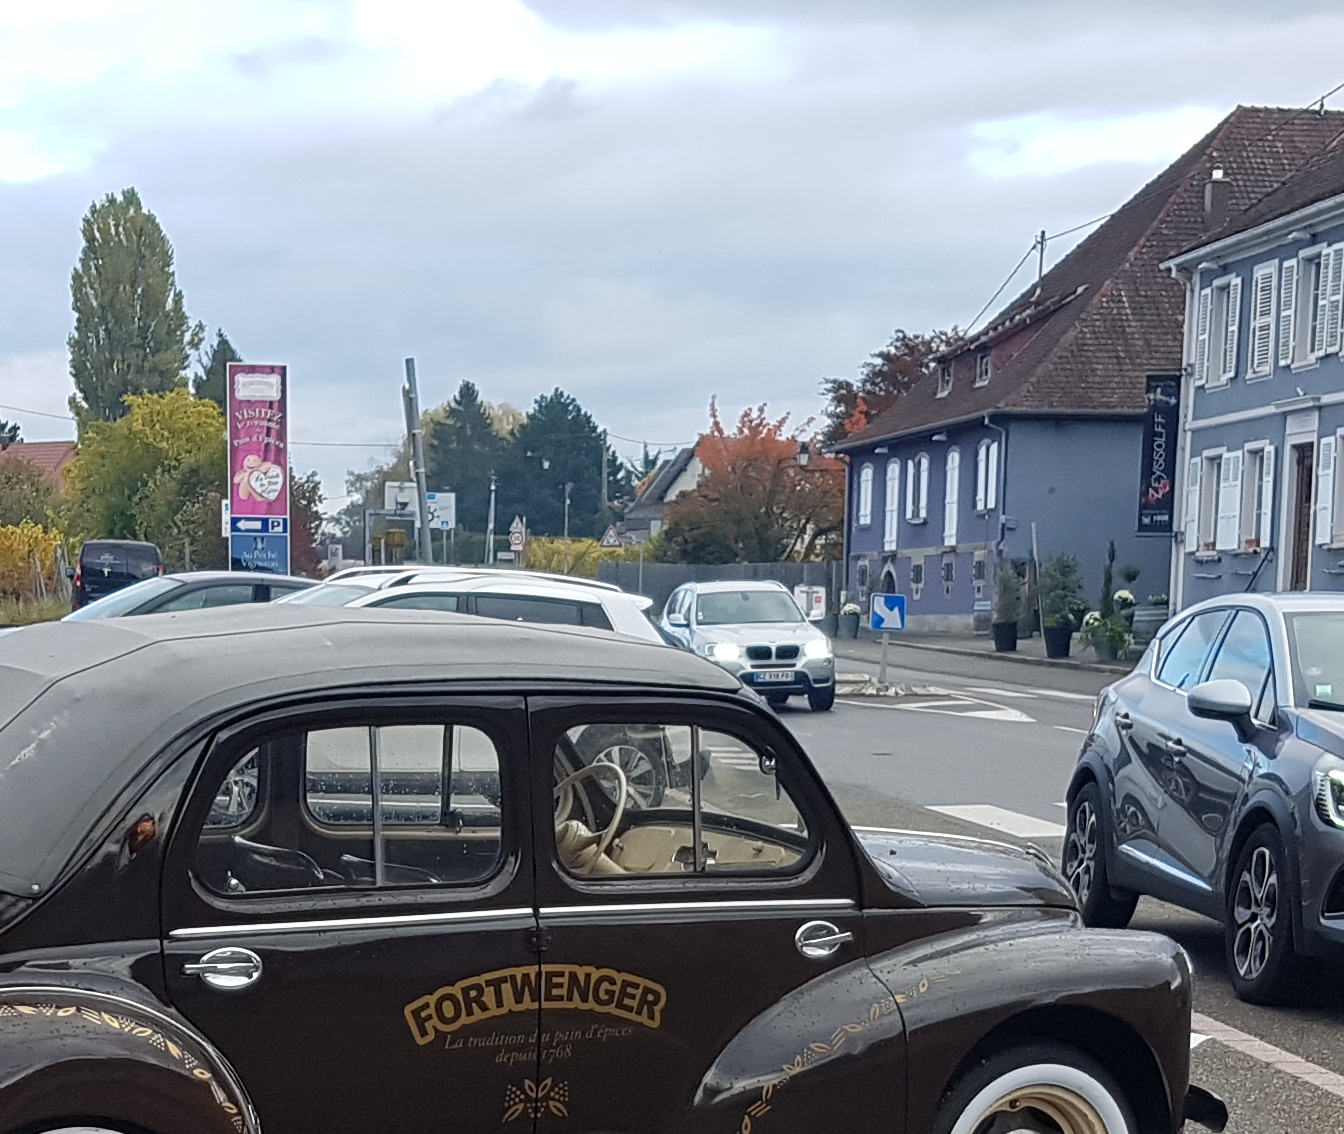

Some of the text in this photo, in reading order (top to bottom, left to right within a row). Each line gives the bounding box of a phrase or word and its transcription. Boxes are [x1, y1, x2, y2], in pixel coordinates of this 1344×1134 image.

[235, 408, 283, 422] VISITEZ
[1148, 412, 1167, 499] ZEYSSOLFF
[270, 520, 281, 531] P
[409, 968, 664, 1041] FORTWENGER
[444, 1023, 635, 1049] La tradition du pain d'épices
[494, 1044, 573, 1066] depuis 1768
